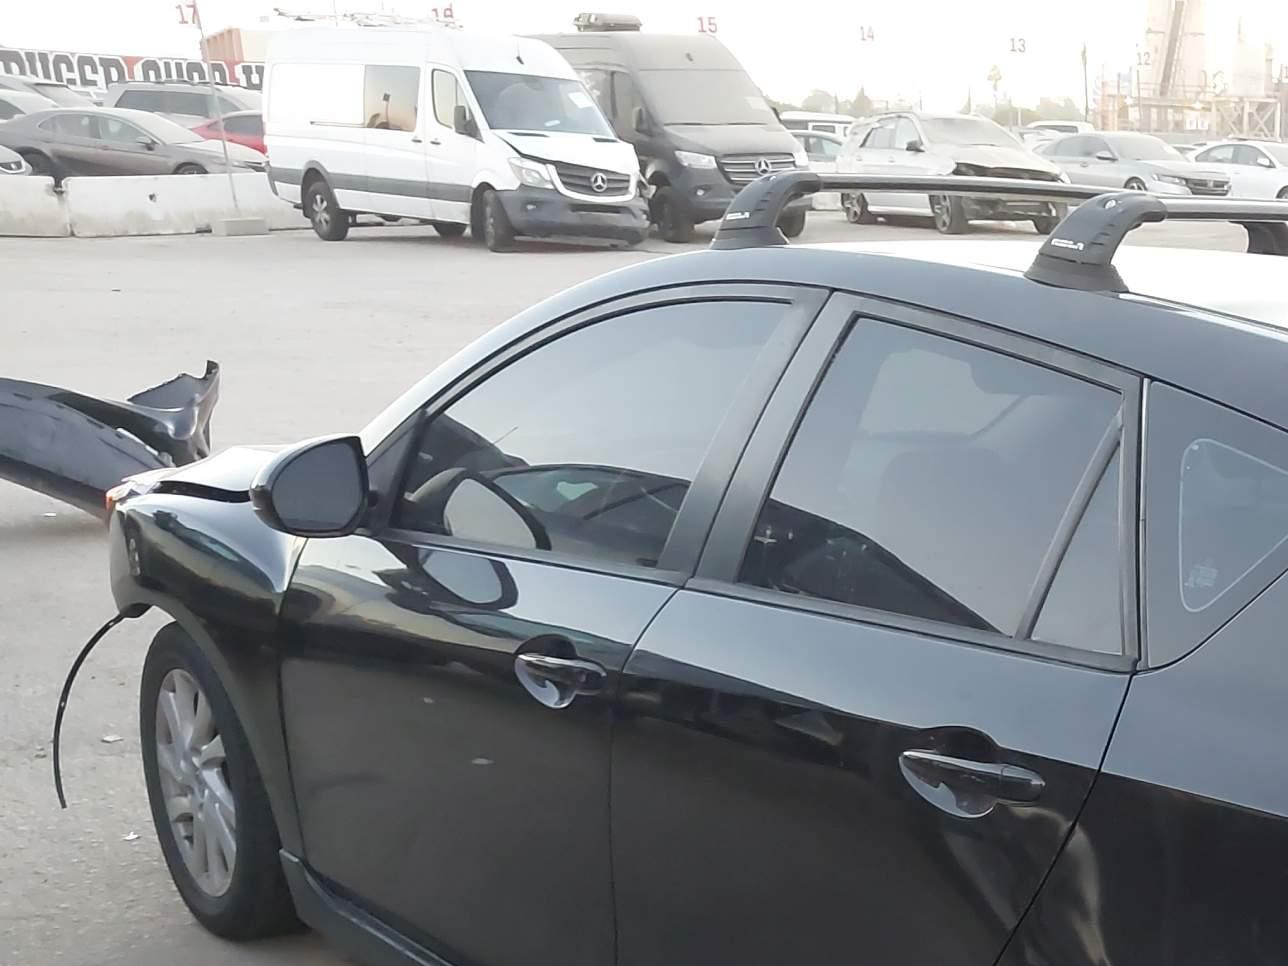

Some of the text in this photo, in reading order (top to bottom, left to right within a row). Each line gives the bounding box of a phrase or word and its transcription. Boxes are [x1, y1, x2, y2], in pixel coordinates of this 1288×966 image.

[175, 4, 198, 25] 17
[697, 16, 718, 33] 15
[860, 25, 875, 41] 14
[1009, 37, 1026, 53] 13
[1137, 51, 1151, 66] 12
